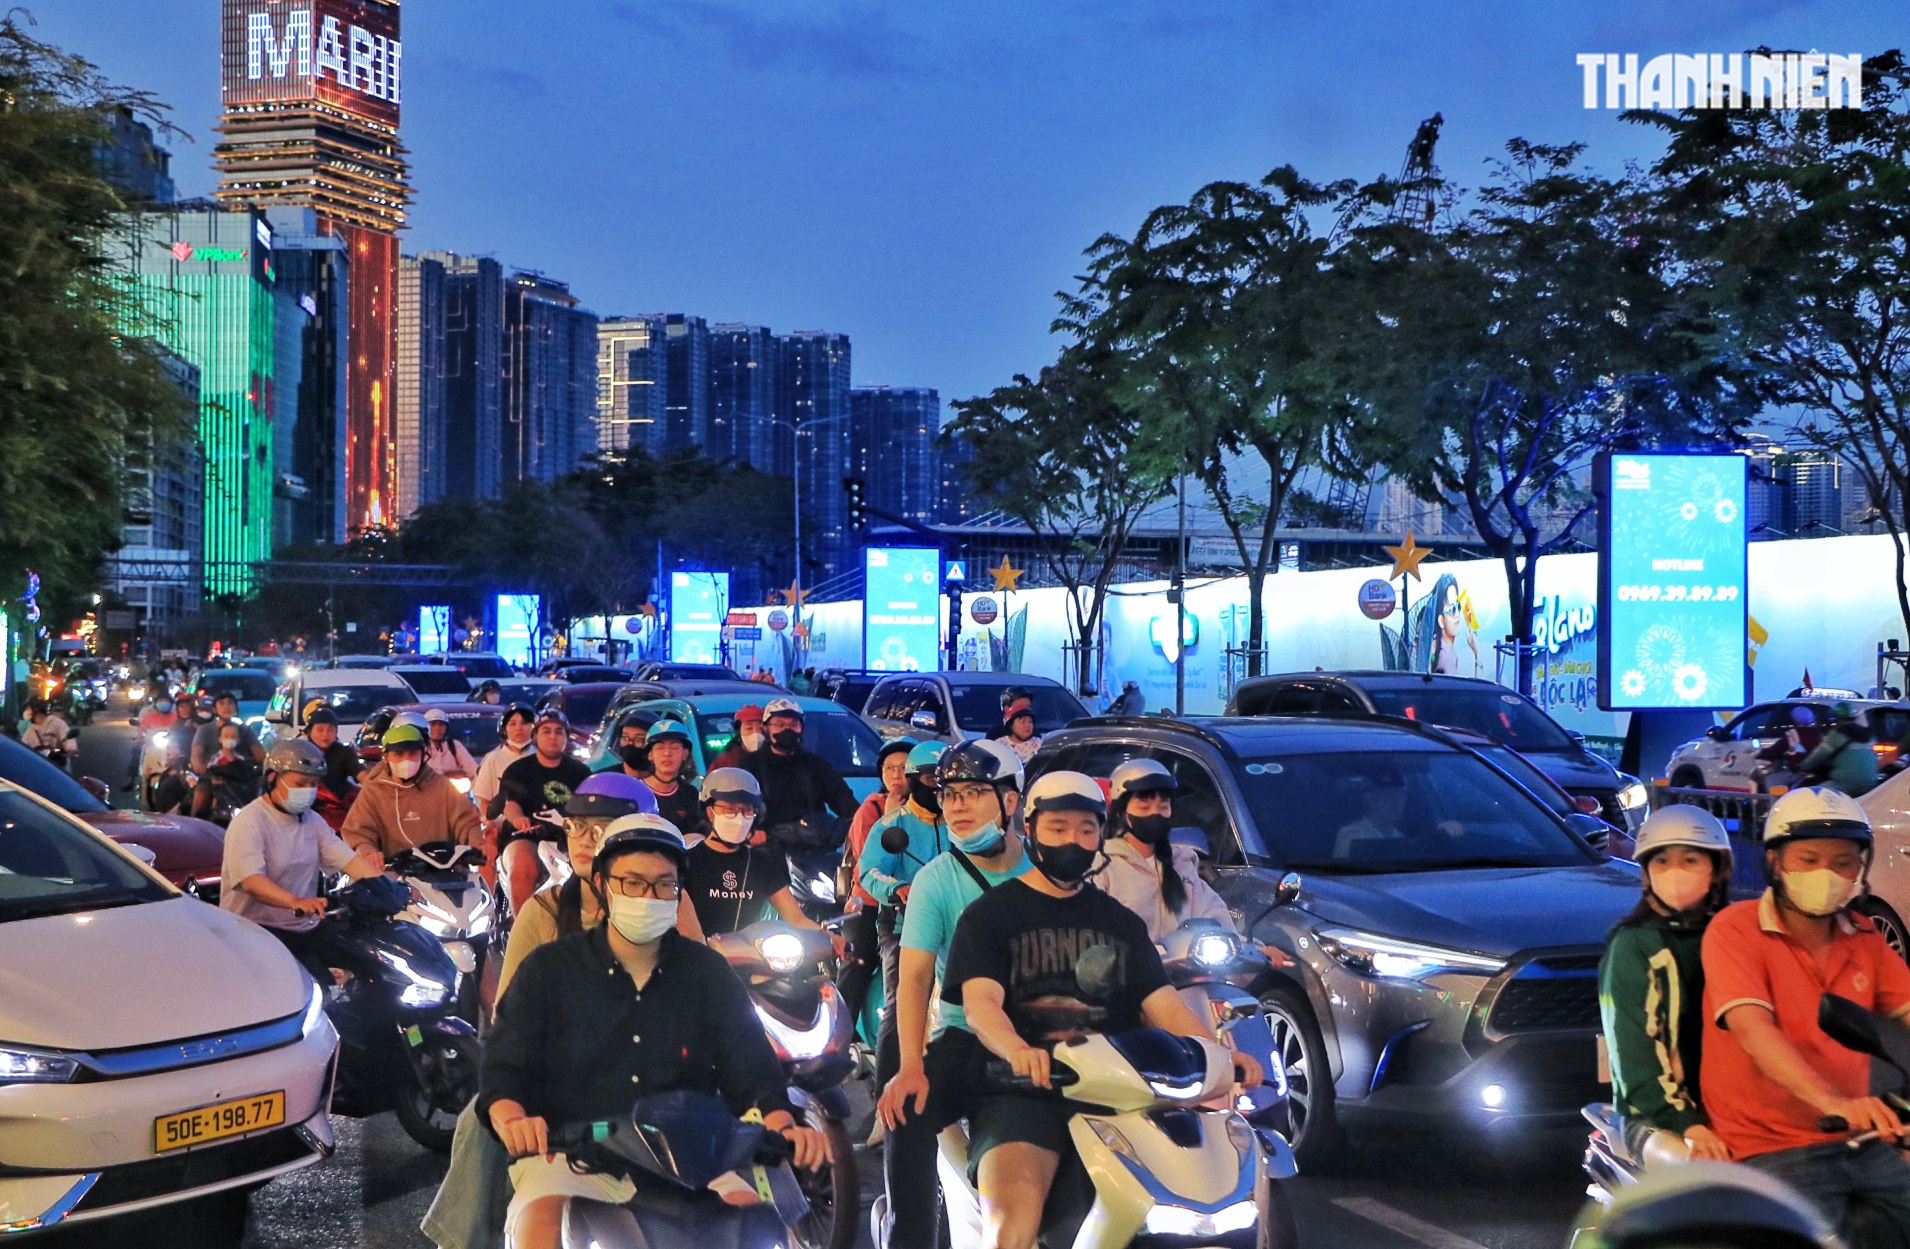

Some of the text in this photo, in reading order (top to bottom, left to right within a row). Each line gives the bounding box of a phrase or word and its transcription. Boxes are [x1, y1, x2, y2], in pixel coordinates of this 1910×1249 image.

[194, 248, 247, 261] VPBank
[1652, 559, 1704, 571] HOTLINE
[1368, 592, 1388, 600] Bank
[1617, 585, 1739, 601] 0969.39.89.89
[1532, 595, 1595, 656] elano
[709, 889, 754, 900] Money
[166, 1099, 274, 1143] 50E-198.77
